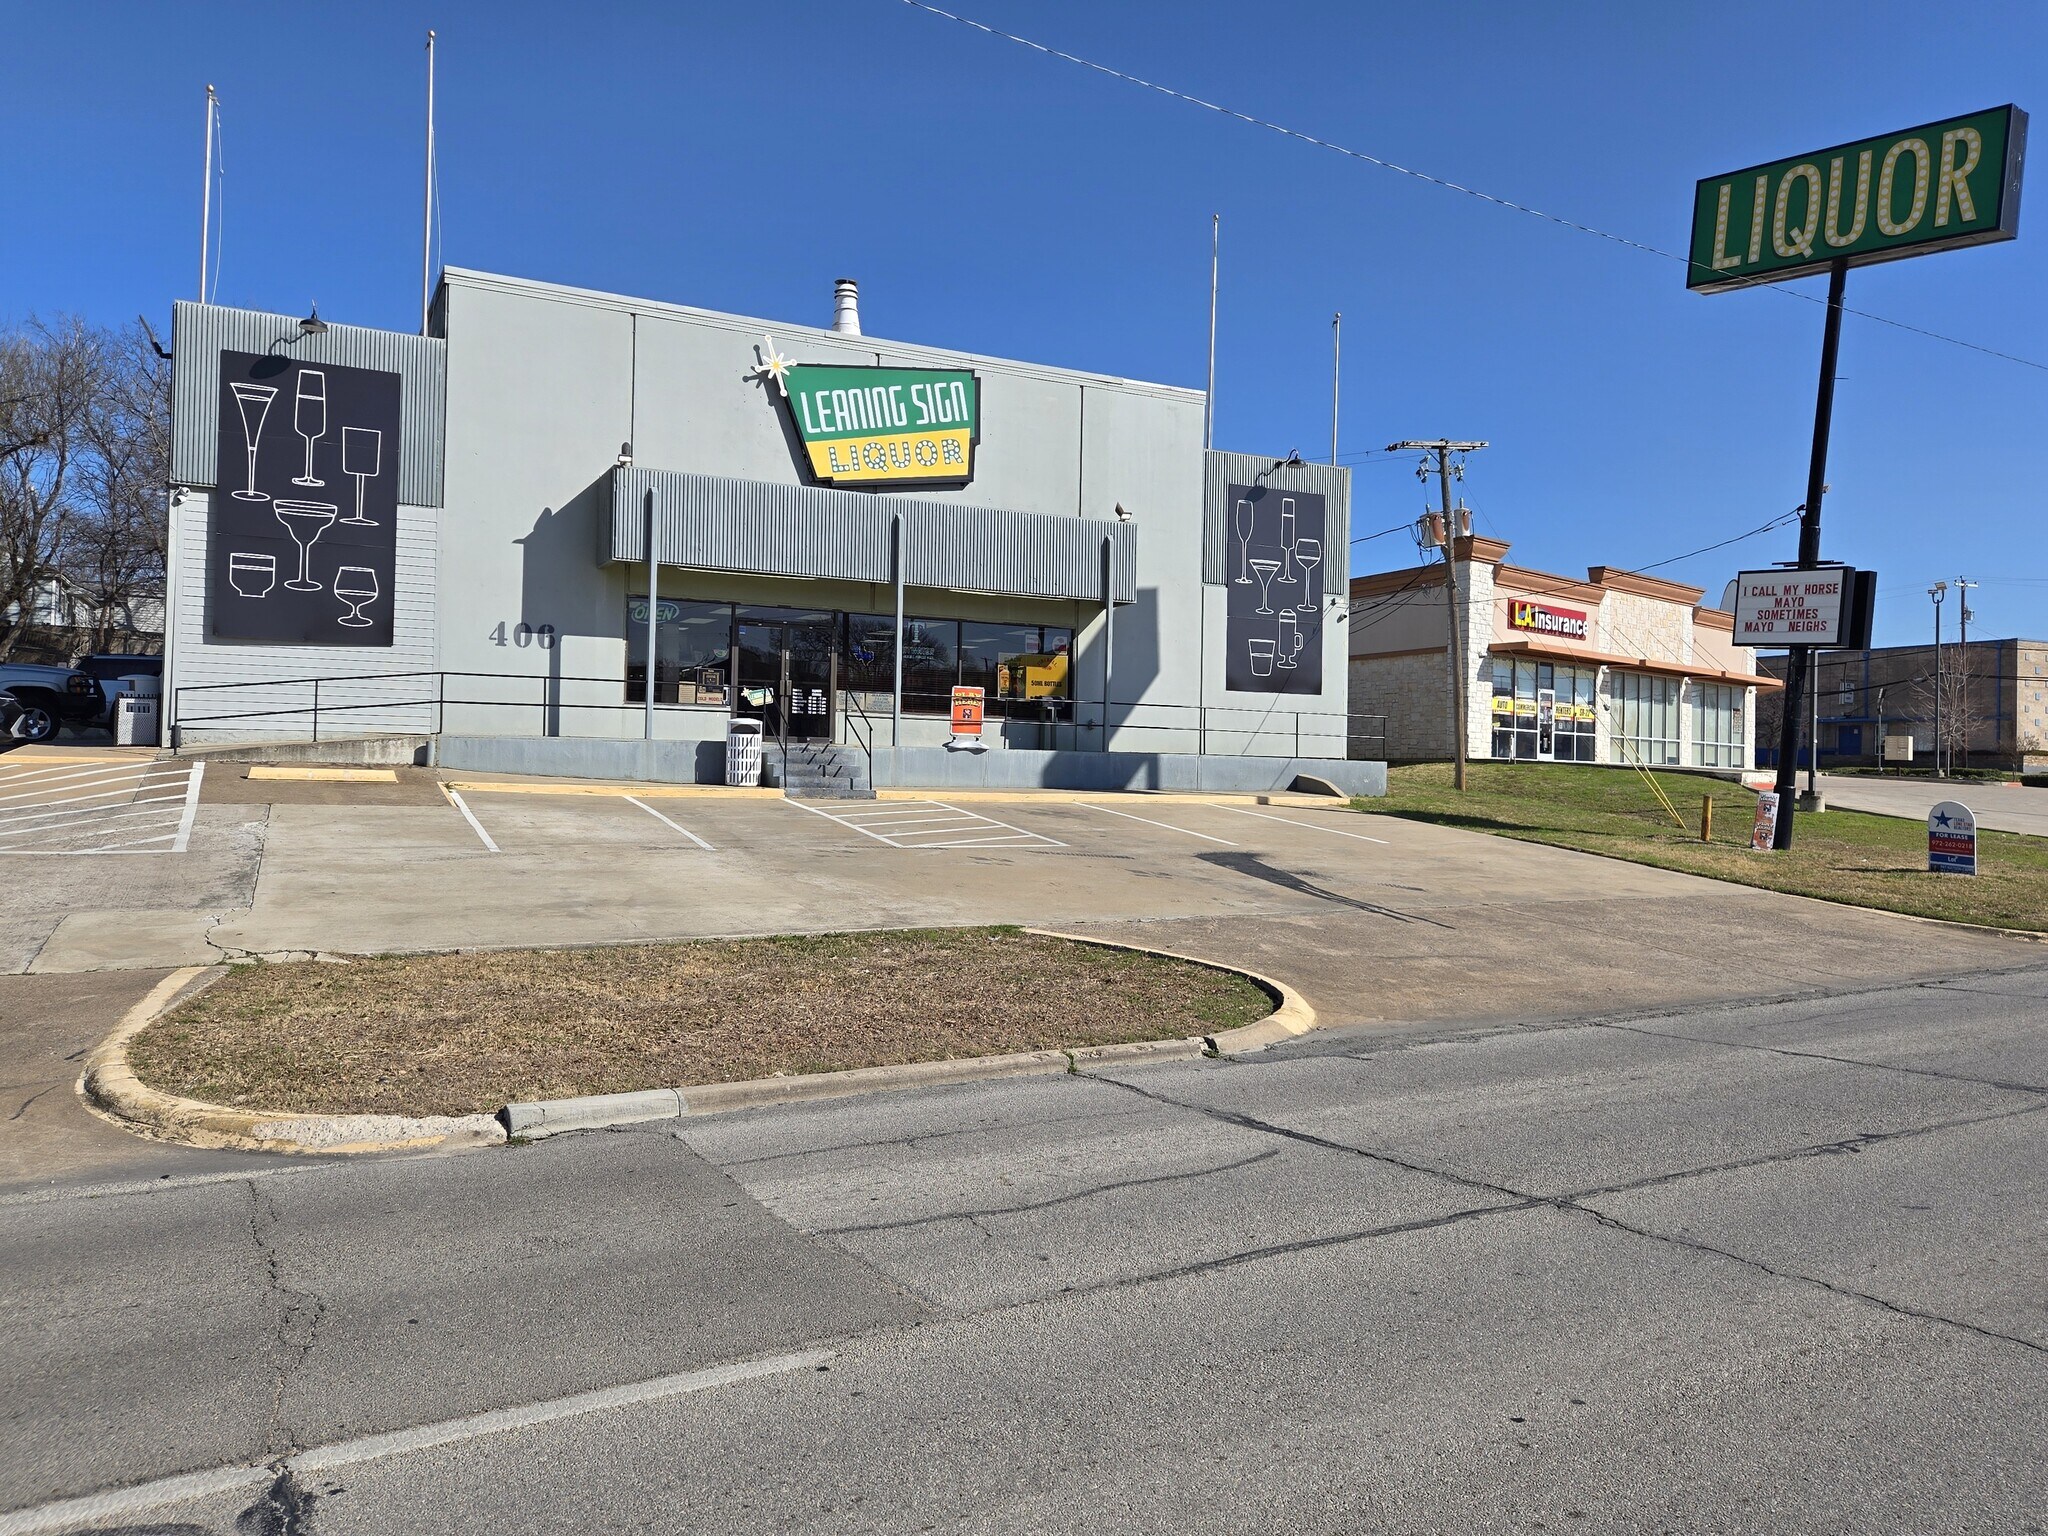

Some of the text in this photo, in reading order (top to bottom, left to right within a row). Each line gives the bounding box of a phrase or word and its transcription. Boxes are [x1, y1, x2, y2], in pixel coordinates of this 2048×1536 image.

[1711, 126, 1982, 270] LIQUOR
[800, 381, 969, 434] LEANING SIGN
[828, 438, 964, 472] LIQUOR
[1743, 583, 1839, 597] I CALL MY HORSE
[1774, 596, 1805, 608] MAYO
[1757, 608, 1819, 620] SOMETIMES
[1744, 620, 1828, 632] MAYO NEIGHS
[488, 621, 556, 650] 406
[1496, 700, 1508, 709] AUTO
